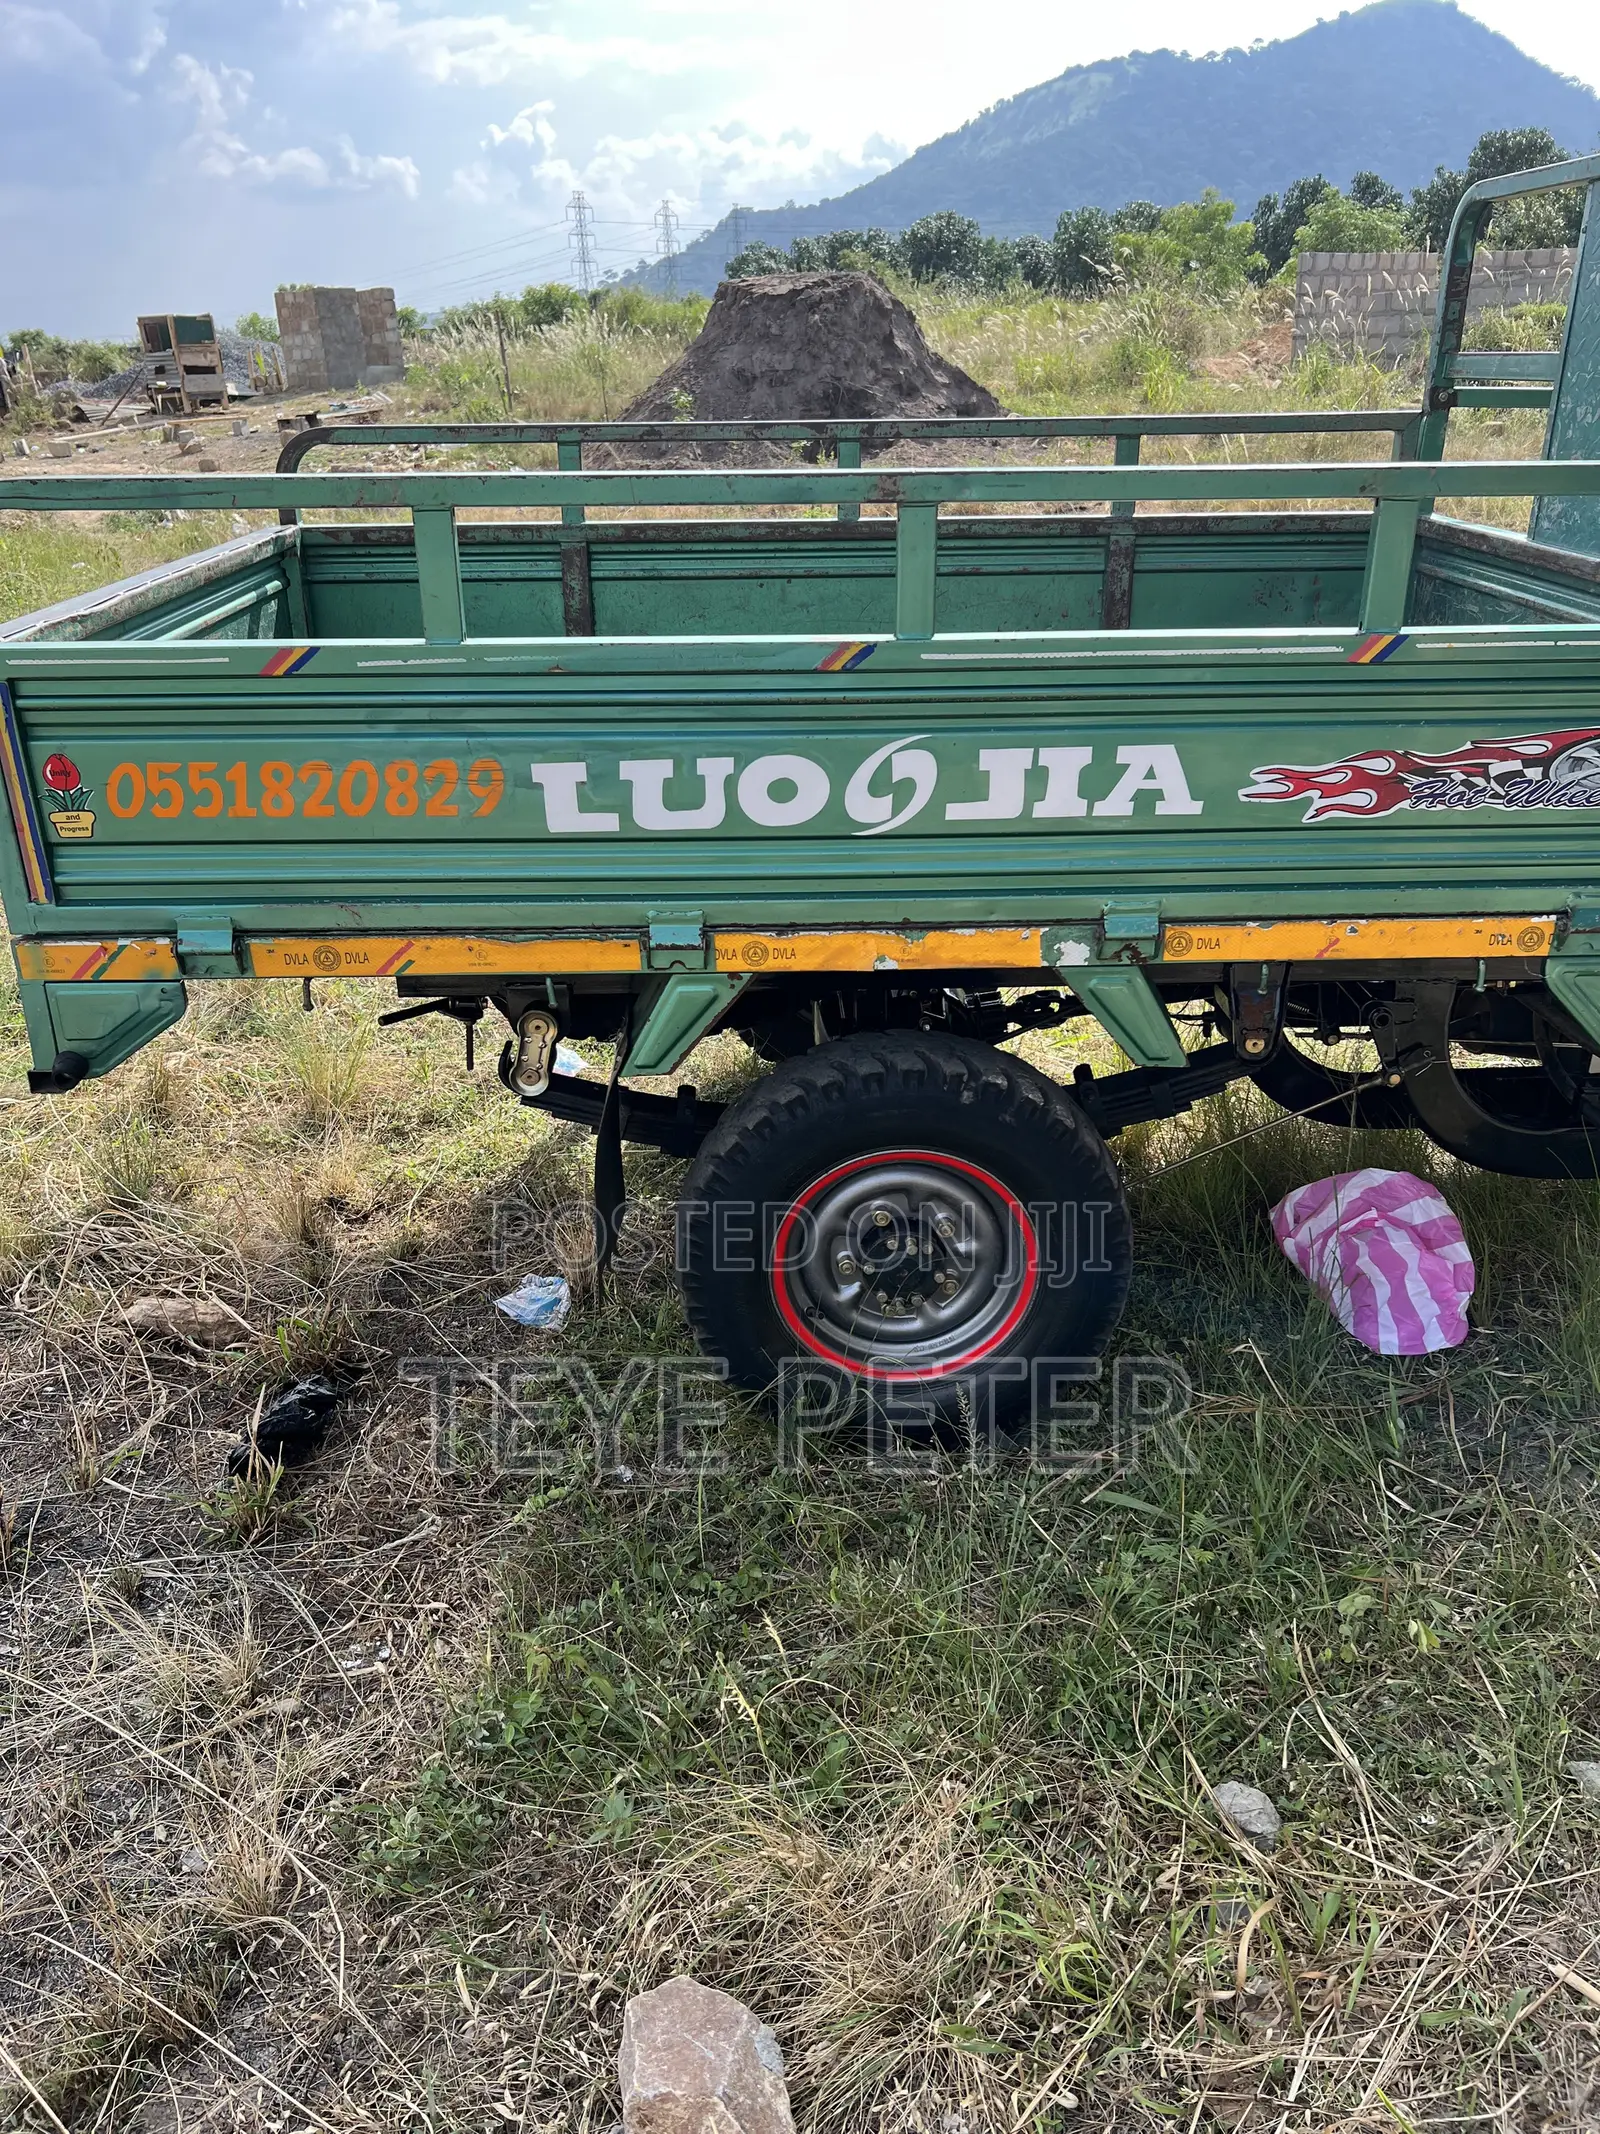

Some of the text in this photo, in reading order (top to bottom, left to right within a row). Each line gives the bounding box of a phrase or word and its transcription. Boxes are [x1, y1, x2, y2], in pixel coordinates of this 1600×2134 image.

[105, 758, 505, 818] 0551820829
[530, 744, 1204, 833] LUO JIA
[1408, 777, 1492, 808] Hot
[59, 825, 90, 833] Progress
[1196, 937, 1221, 950] DVLA
[283, 953, 310, 966] DVLA
[344, 952, 370, 965] DVLA
[772, 947, 797, 960] DVLA
